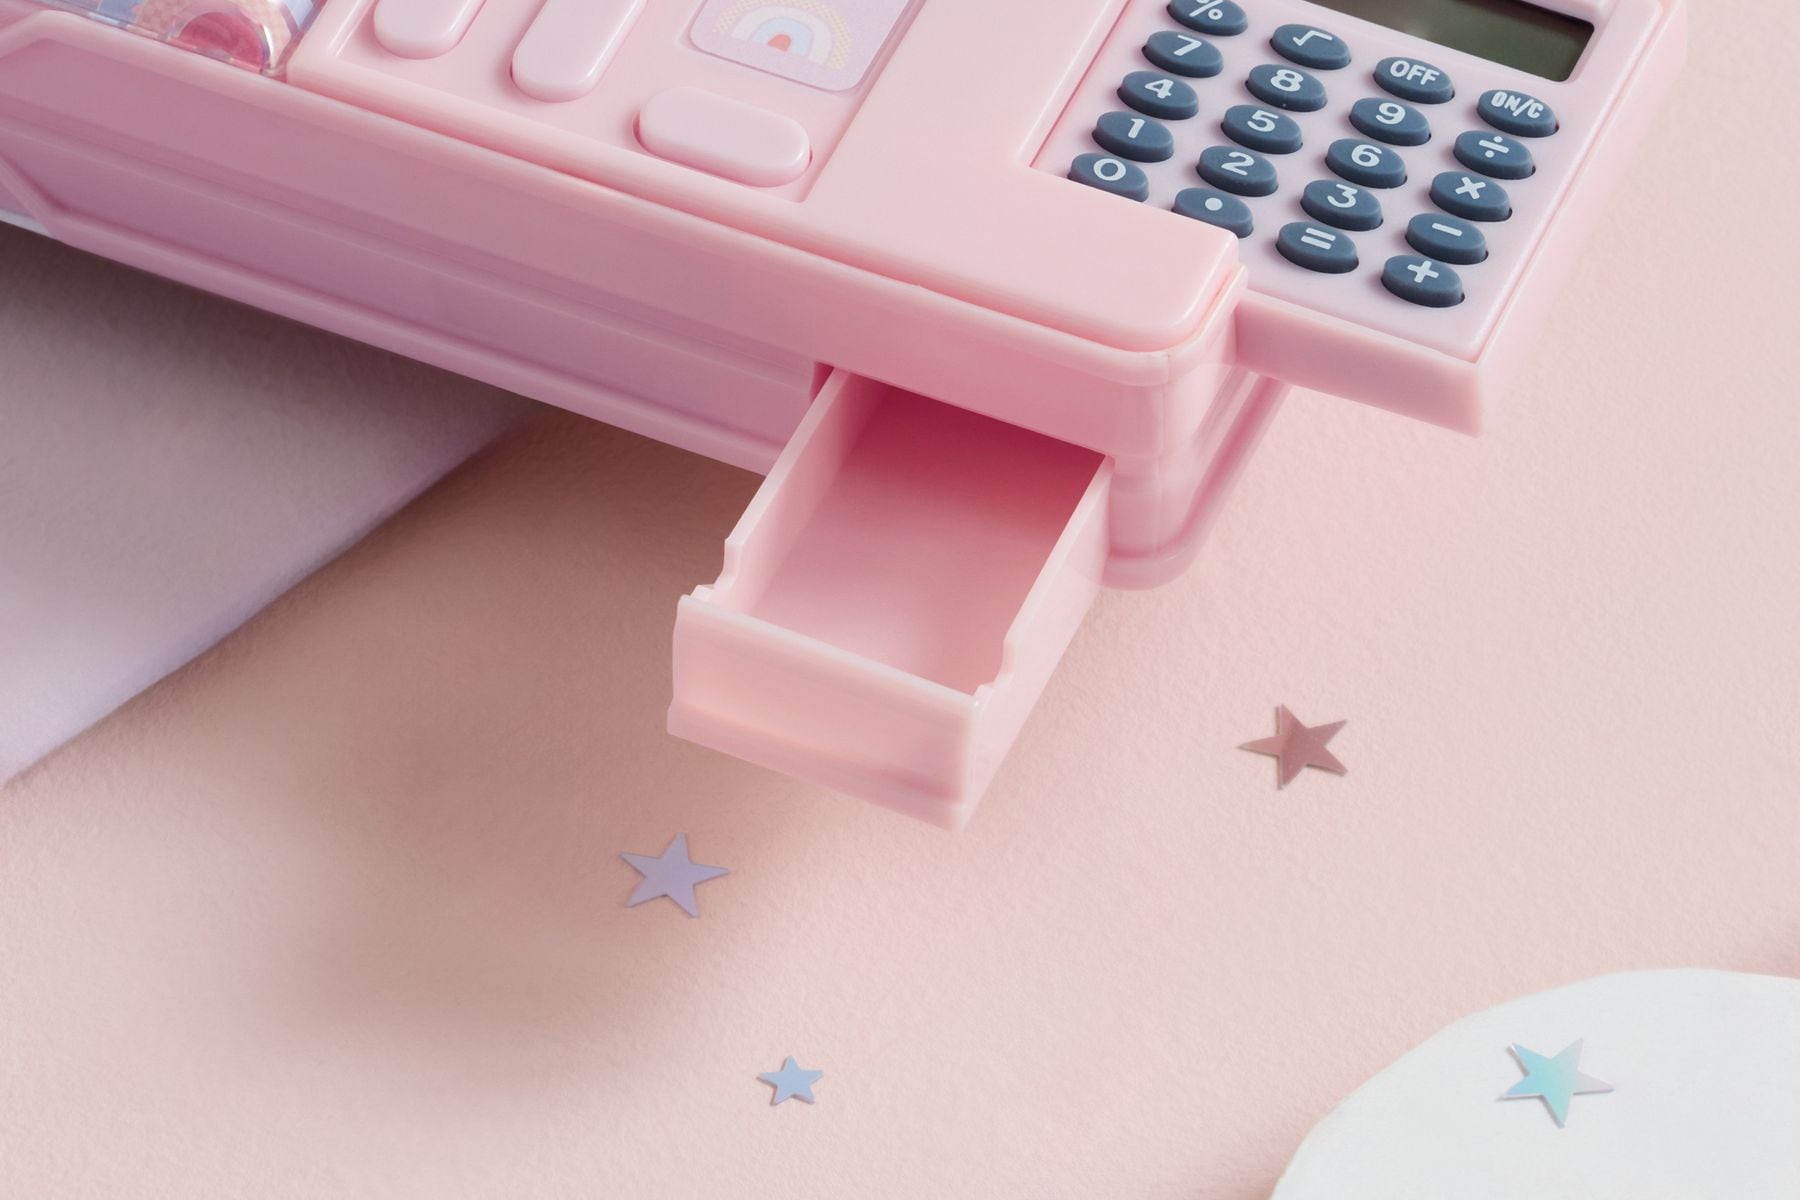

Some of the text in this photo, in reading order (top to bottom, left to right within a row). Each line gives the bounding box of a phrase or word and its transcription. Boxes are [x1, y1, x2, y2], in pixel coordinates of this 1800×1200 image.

[1174, 35, 1204, 56] 7
[1271, 69, 1306, 91] 8
[1389, 60, 1440, 85] OFF
[1145, 79, 1173, 98] 4
[1376, 103, 1408, 124] 9
[1491, 91, 1544, 119] ON/C
[1128, 119, 1145, 138] 1
[1248, 110, 1278, 131] 5
[1222, 152, 1254, 175] 2
[1352, 145, 1382, 166] 6
[1328, 184, 1357, 207] 3
[1301, 228, 1335, 249] =
[1408, 261, 1439, 282] +
